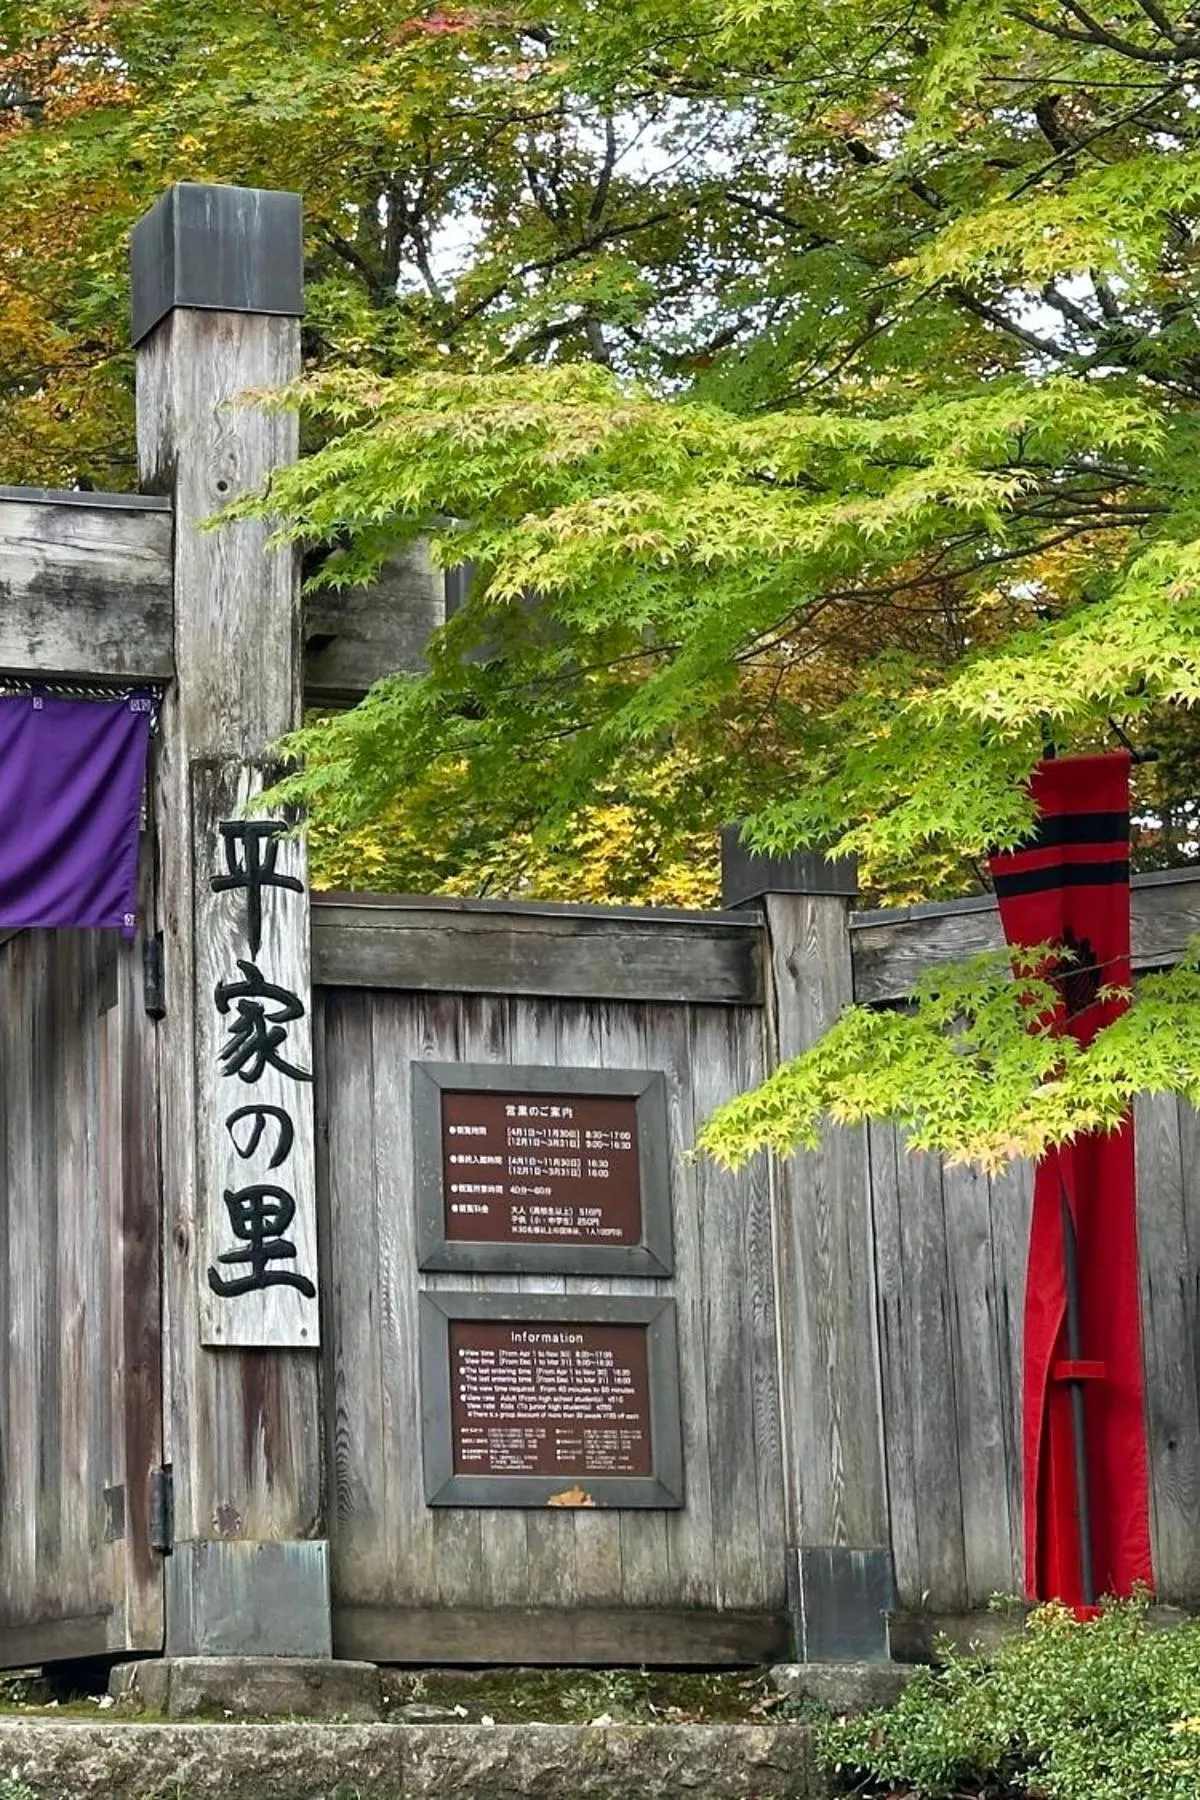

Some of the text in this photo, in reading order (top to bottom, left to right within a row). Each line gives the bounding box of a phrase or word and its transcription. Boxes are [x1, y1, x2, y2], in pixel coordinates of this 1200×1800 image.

[208, 820, 317, 1298] 平家の里
[506, 1105, 572, 1118] 営業のご案内
[511, 1331, 583, 1343] Information
